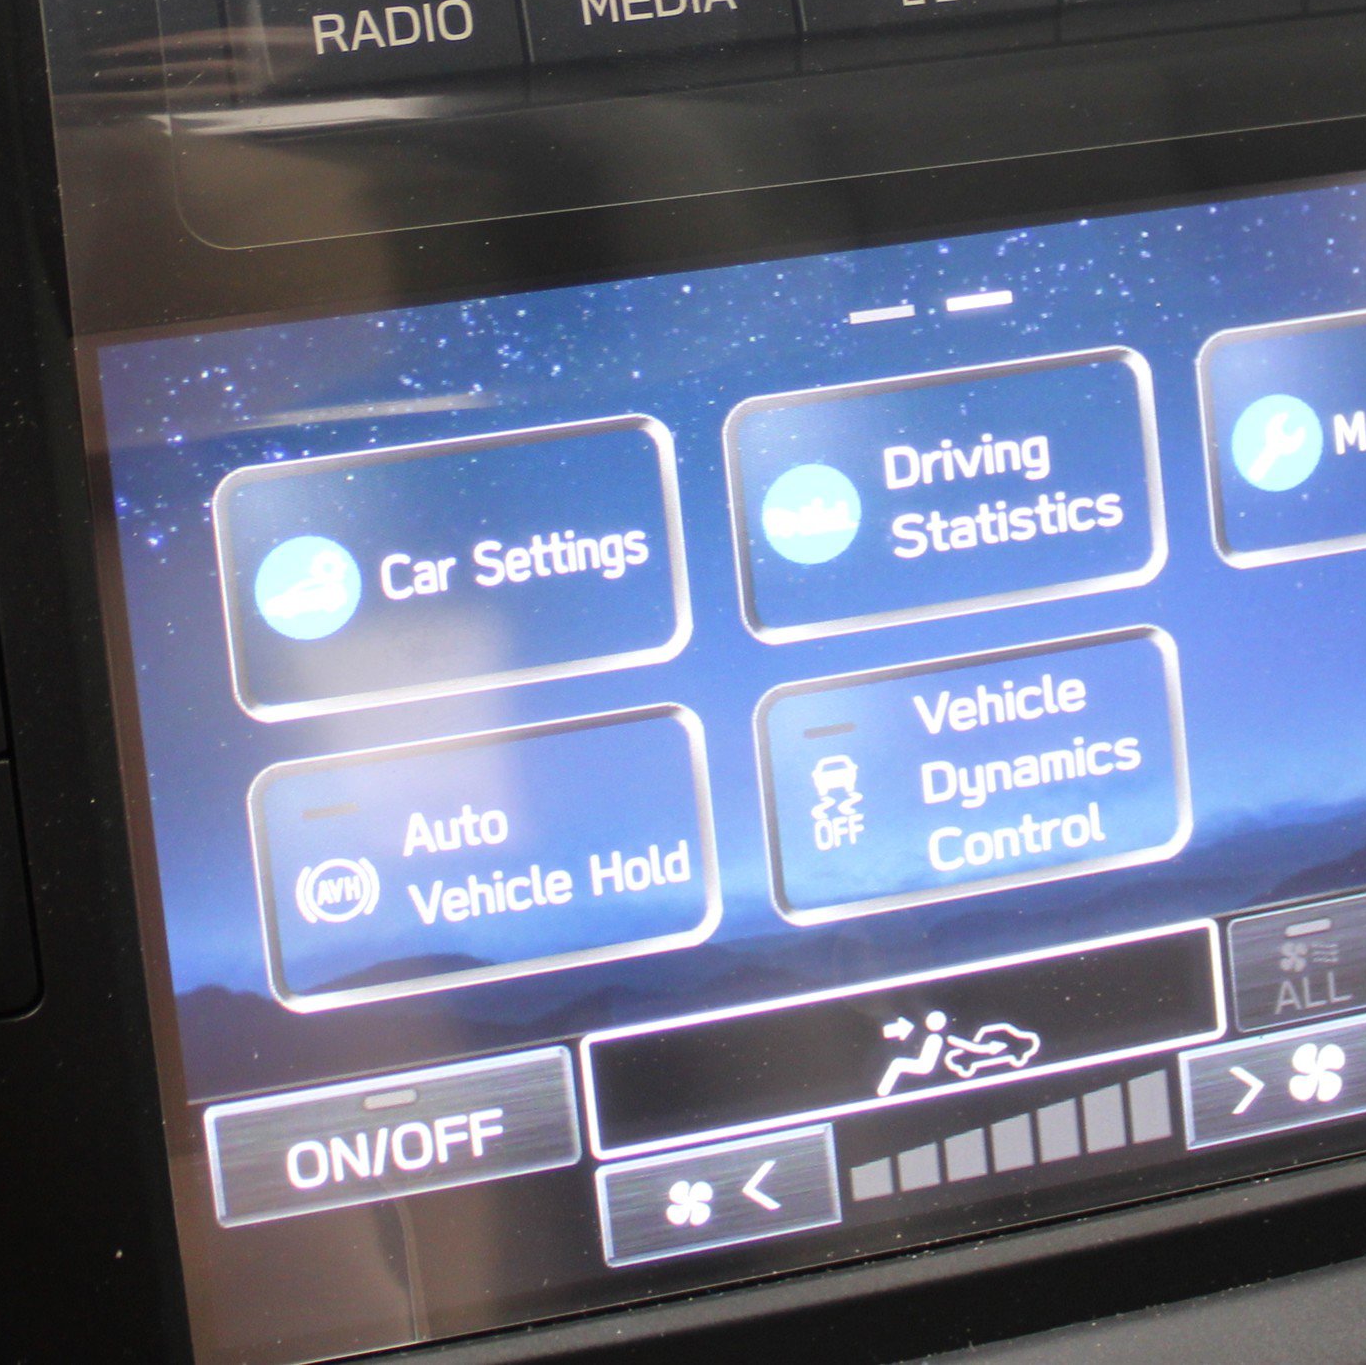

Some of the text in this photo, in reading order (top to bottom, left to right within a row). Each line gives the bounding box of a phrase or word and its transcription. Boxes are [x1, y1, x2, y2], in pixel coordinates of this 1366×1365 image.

[882, 432, 1052, 491] Driving
[890, 490, 1125, 559] Statistics
[379, 528, 650, 601] Car Settings
[912, 674, 1087, 736] Vehicle
[920, 732, 1143, 811] Dynamics
[402, 803, 509, 858] Auto
[814, 813, 865, 851] OFF
[927, 801, 1106, 873] Control
[407, 839, 692, 926] Vehicle Hold
[1274, 971, 1353, 1016] ALL
[286, 1107, 504, 1191] ON/OFF
